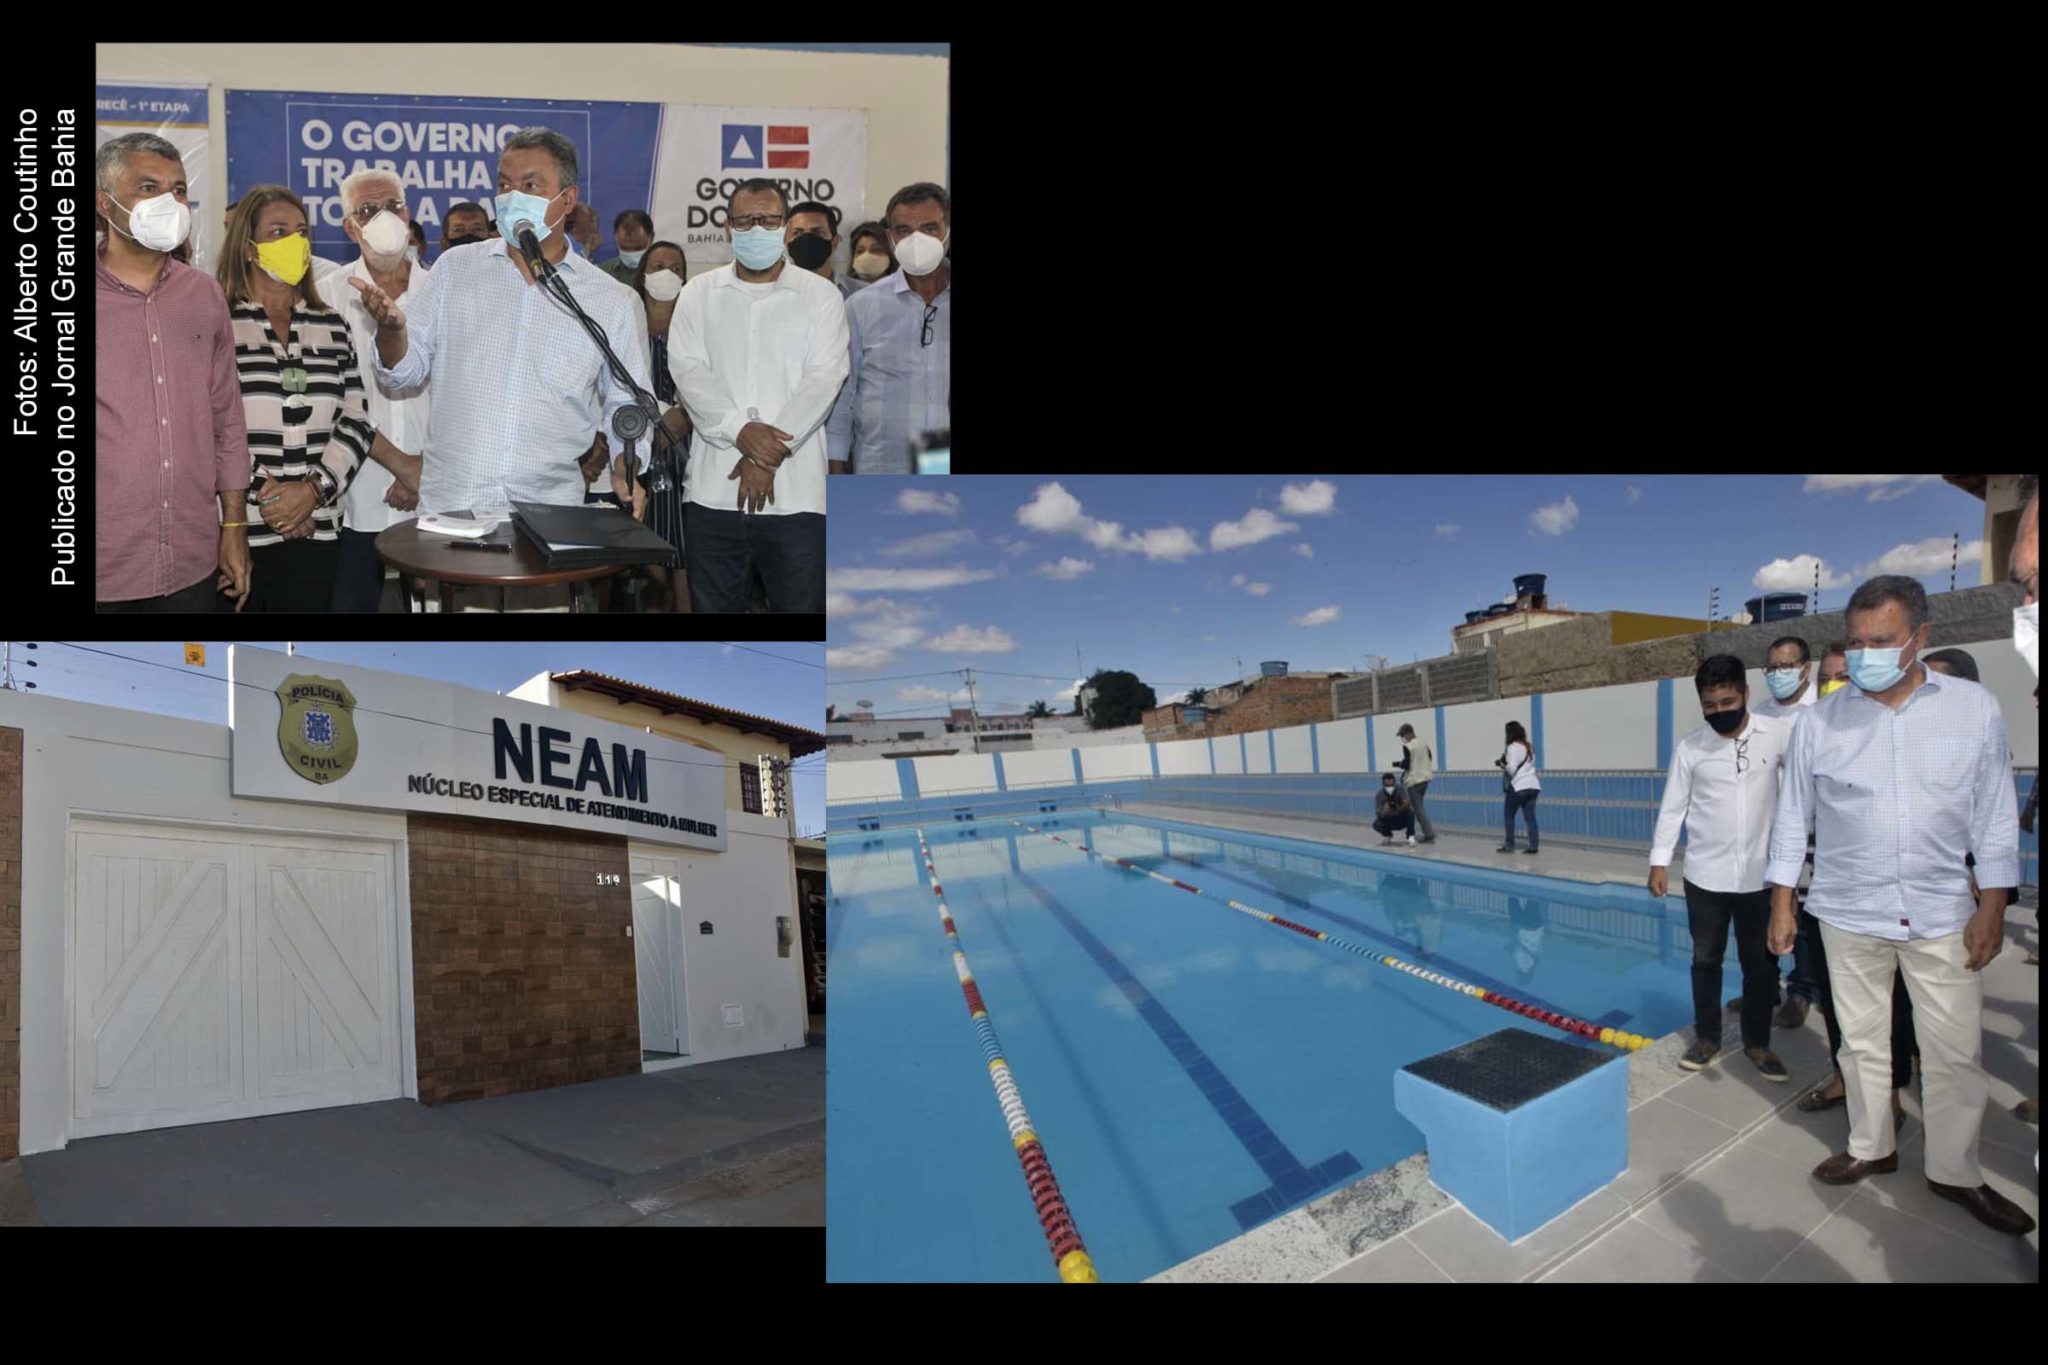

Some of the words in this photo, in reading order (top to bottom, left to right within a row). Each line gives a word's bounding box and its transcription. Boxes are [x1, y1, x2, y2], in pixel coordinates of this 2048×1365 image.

[150, 101, 190, 113] ETAPA
[301, 119, 333, 151] O
[696, 177, 835, 202] GORNO
[687, 205, 730, 229] DO
[687, 233, 725, 244] BAHIA
[291, 686, 345, 704] POLÍCIA
[300, 755, 342, 769] CIVIL
[493, 717, 649, 803] NEAM
[408, 772, 484, 801] NÚCLEO
[487, 785, 564, 811] ESPECIAL
[565, 797, 585, 814] DE
[586, 801, 669, 828] ATENDIMENTO
[678, 817, 718, 837] MULHER
[596, 872, 621, 886] 119
